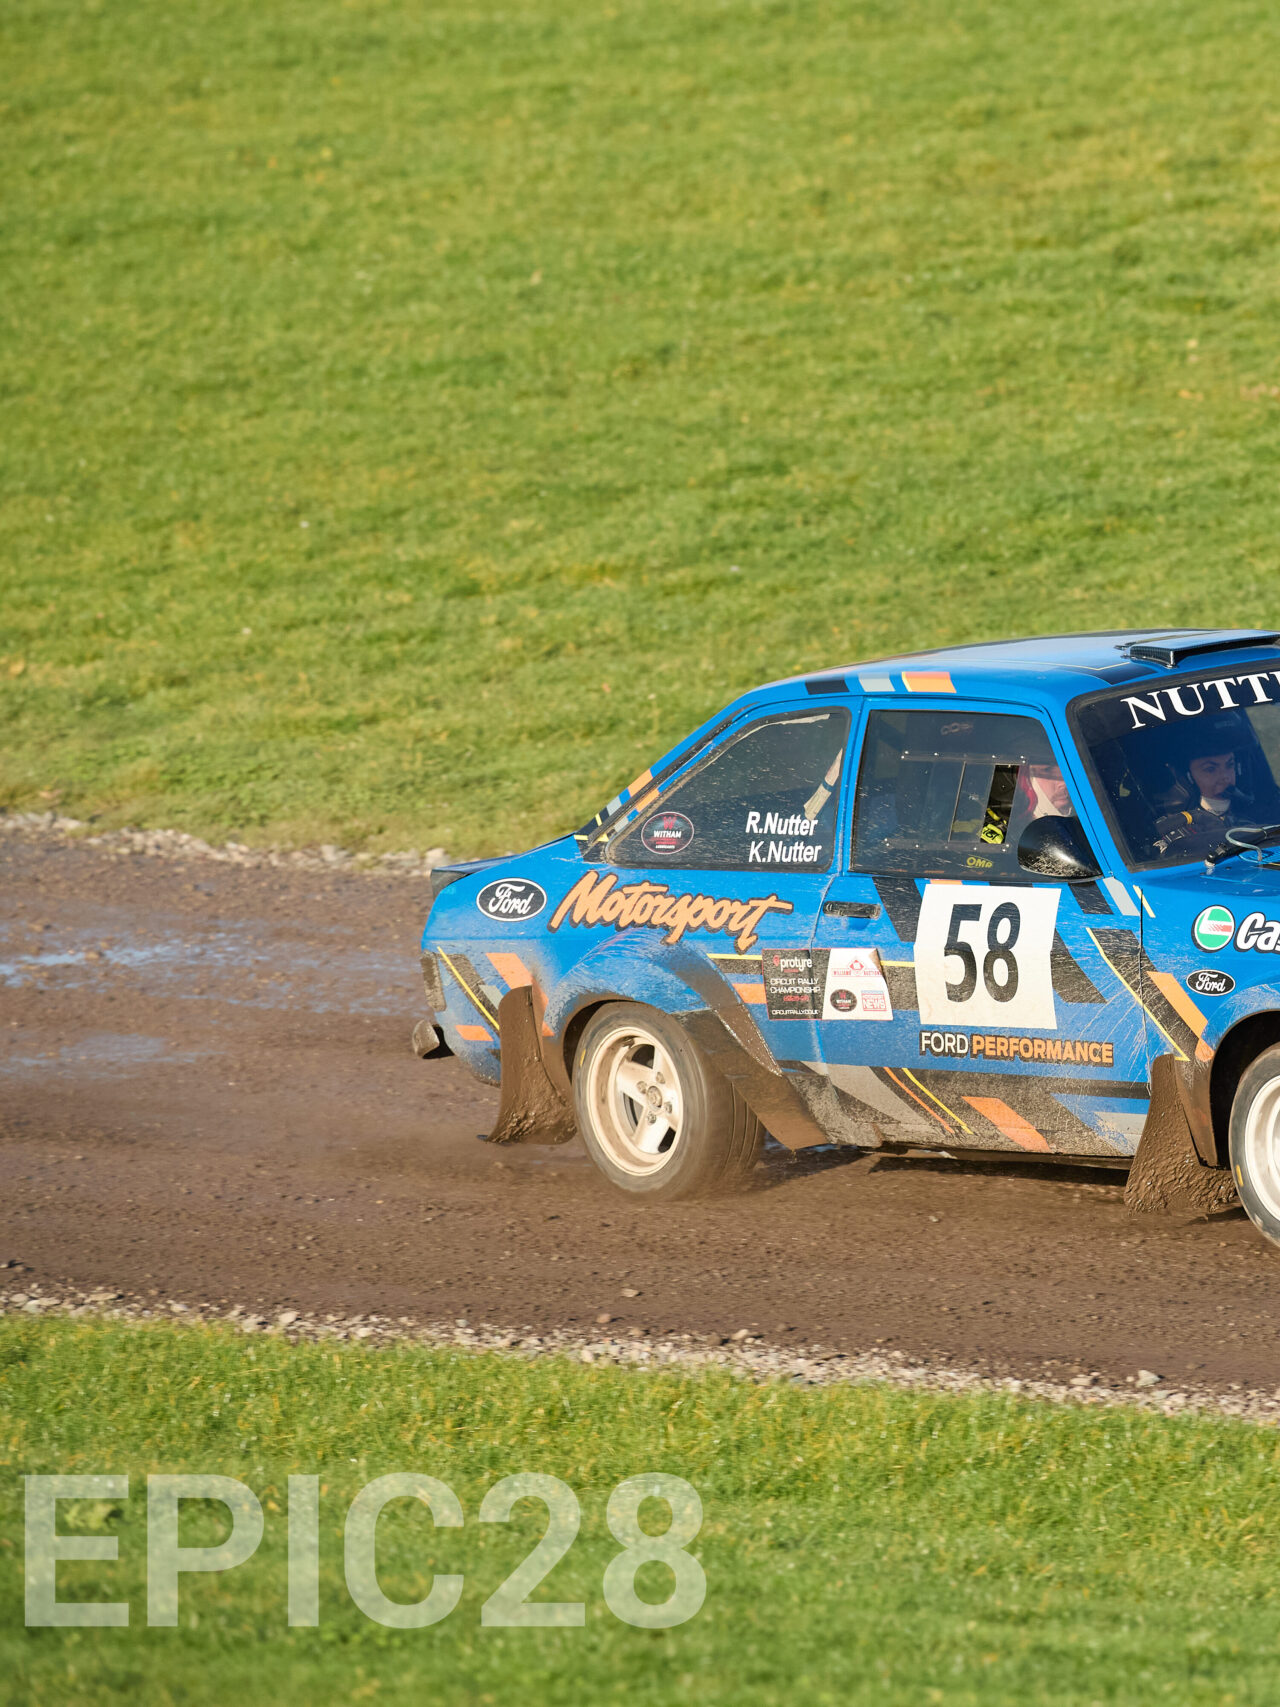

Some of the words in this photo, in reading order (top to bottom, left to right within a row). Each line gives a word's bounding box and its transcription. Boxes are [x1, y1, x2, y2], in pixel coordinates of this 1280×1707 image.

[653, 830, 682, 838] WITHAM
[745, 811, 818, 836] R.Nutter
[748, 840, 822, 863] K.Nutter
[966, 856, 993, 868] OMP
[488, 883, 535, 915] Ford
[549, 871, 793, 953] Motorsport
[944, 901, 1021, 1003] 58
[780, 956, 813, 972] protyre
[770, 977, 796, 985] CIRCUIT
[797, 977, 819, 985] RALLY
[770, 986, 821, 994] CHAMPIONSHIP
[1195, 971, 1226, 992] Ford
[921, 1032, 968, 1055] FORD
[972, 1036, 1113, 1063] PERFORMANCE
